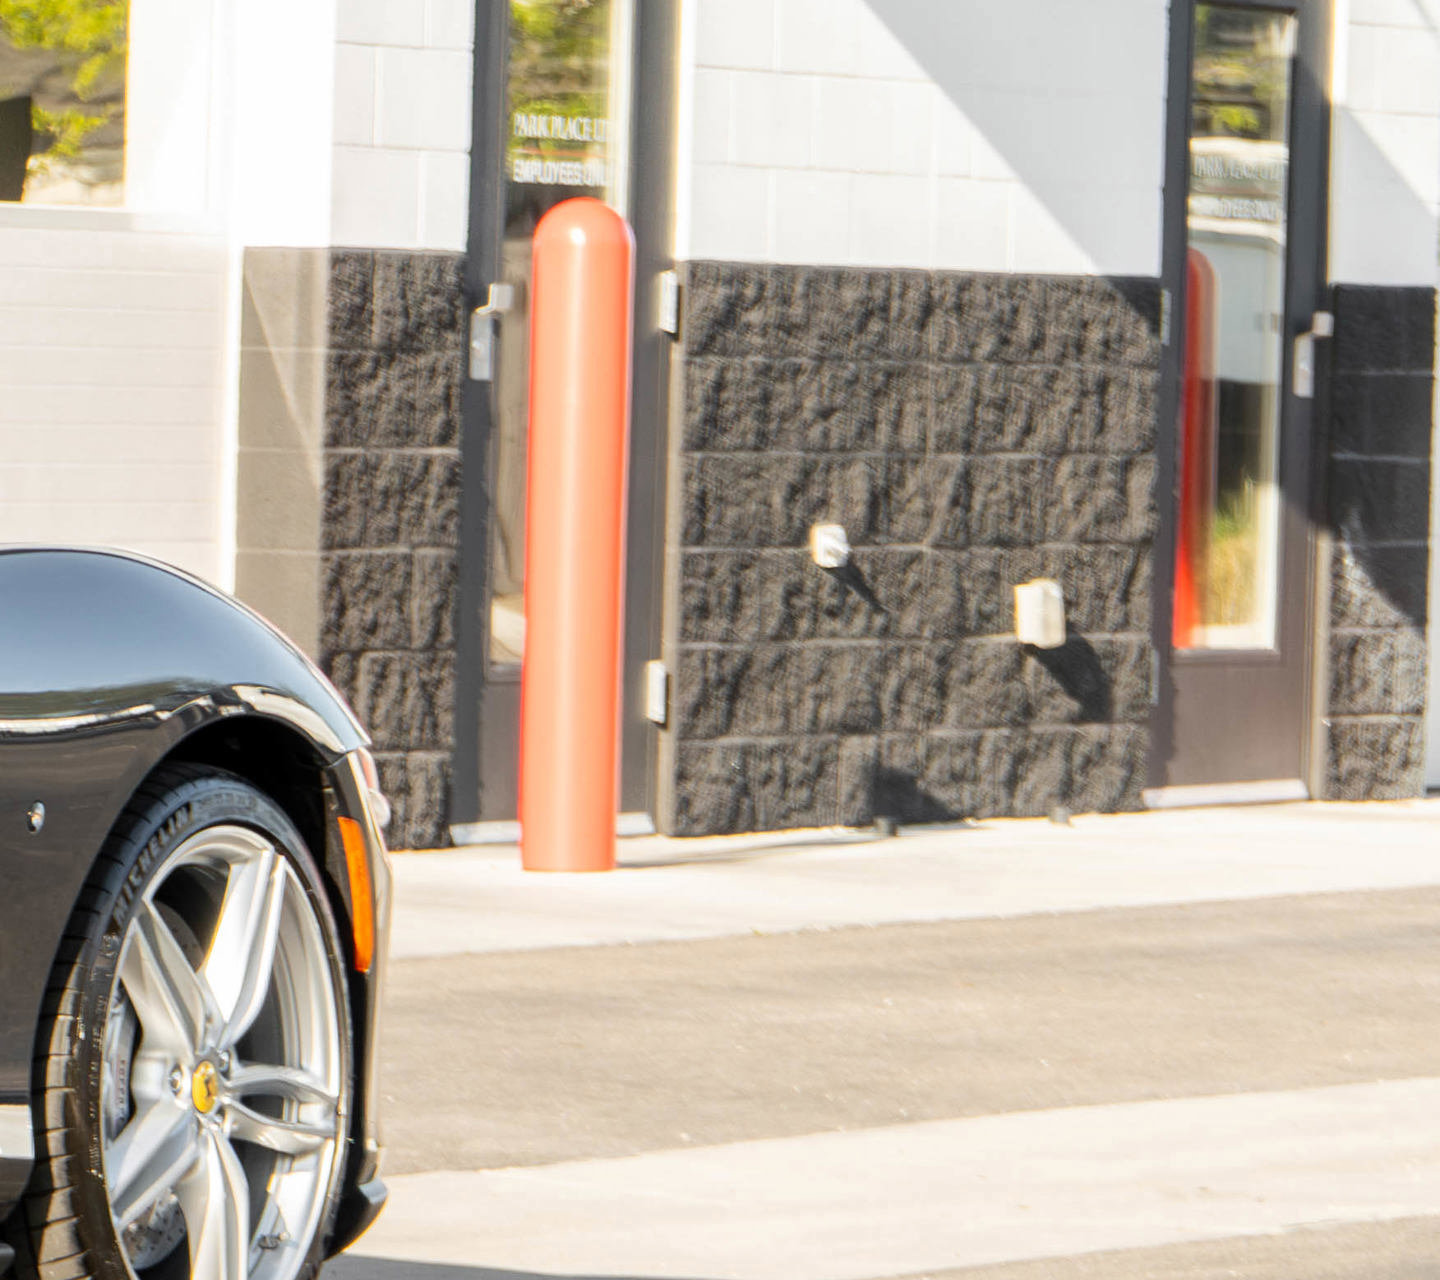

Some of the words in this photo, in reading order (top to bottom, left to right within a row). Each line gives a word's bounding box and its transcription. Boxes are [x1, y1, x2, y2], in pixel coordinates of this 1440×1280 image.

[514, 112, 550, 138] PARK
[551, 115, 593, 141] PLACE
[113, 803, 191, 927] MICHELIN
